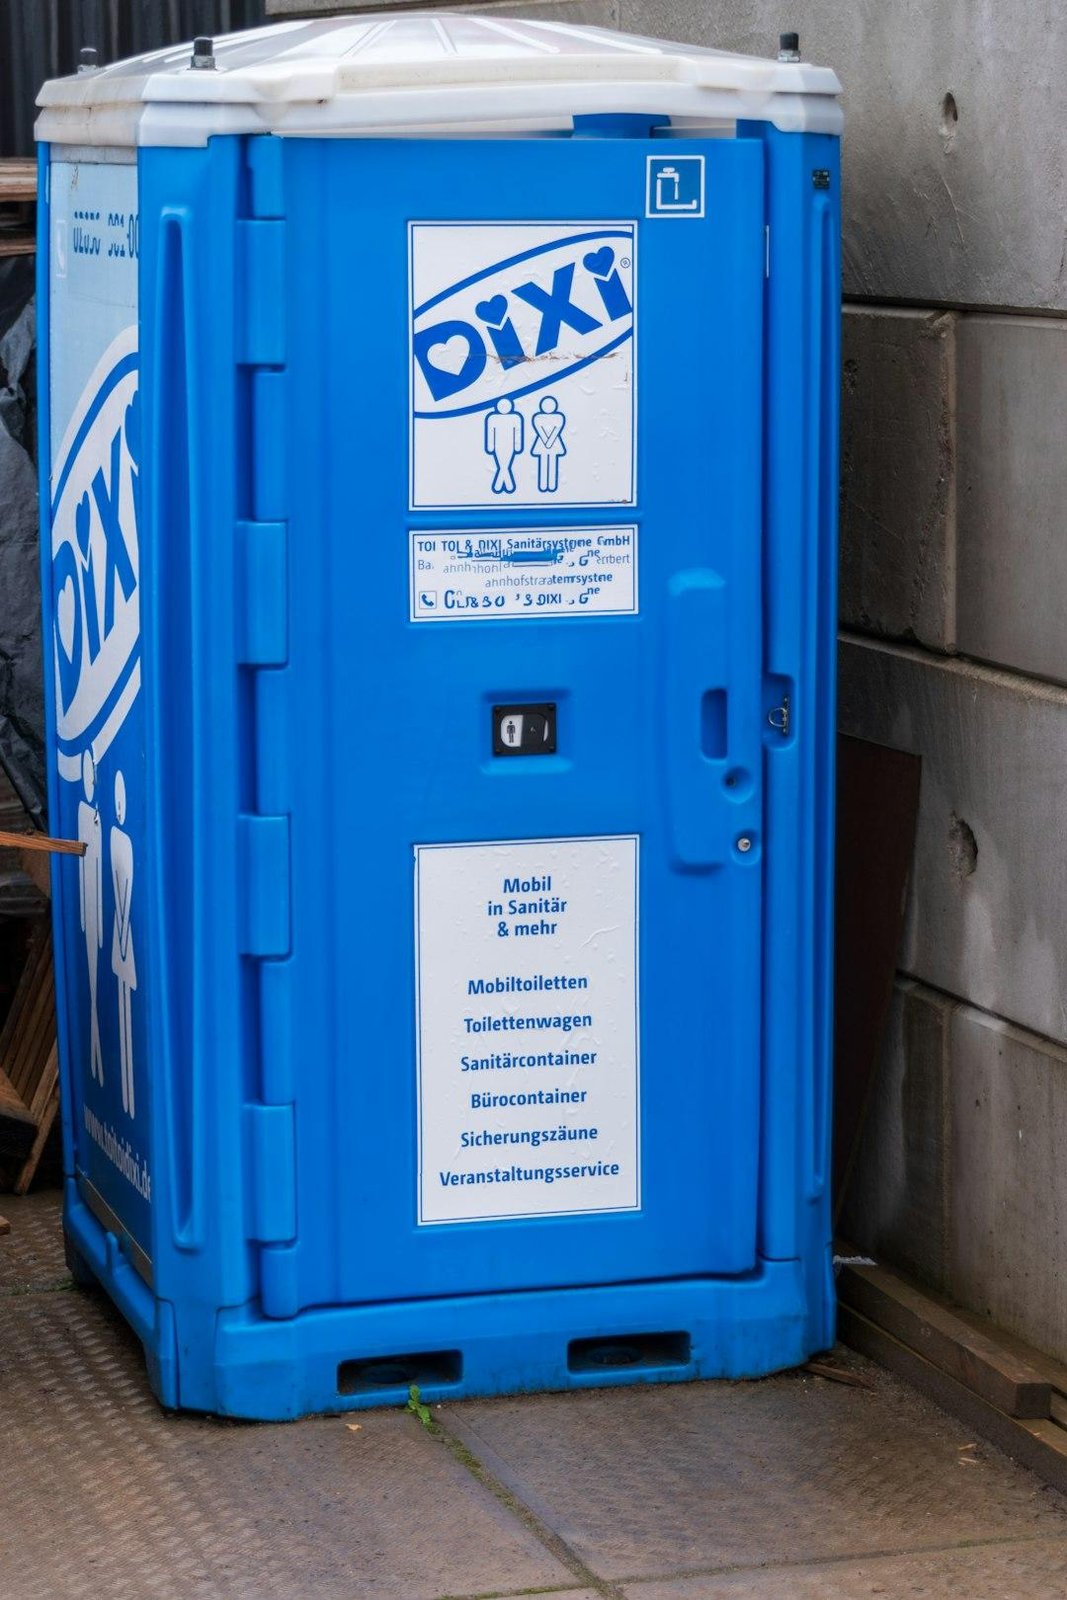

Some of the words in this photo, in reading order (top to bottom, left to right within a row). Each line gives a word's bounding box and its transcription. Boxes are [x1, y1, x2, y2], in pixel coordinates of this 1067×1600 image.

[417, 541, 436, 552] TOI
[503, 876, 551, 893] Mobil
[487, 901, 503, 916] in
[508, 897, 567, 915] Sanitär
[497, 921, 509, 937] &
[514, 920, 557, 936] mehr
[467, 975, 588, 995] Mobiltoiletten
[463, 1014, 592, 1033] Toilettenwagen
[460, 1050, 597, 1071] Sanitärcontainer
[471, 1088, 588, 1108] Bürocontainer
[460, 1125, 598, 1147] Sicherungszäune
[439, 1161, 620, 1186] Veranstaltungsservice
